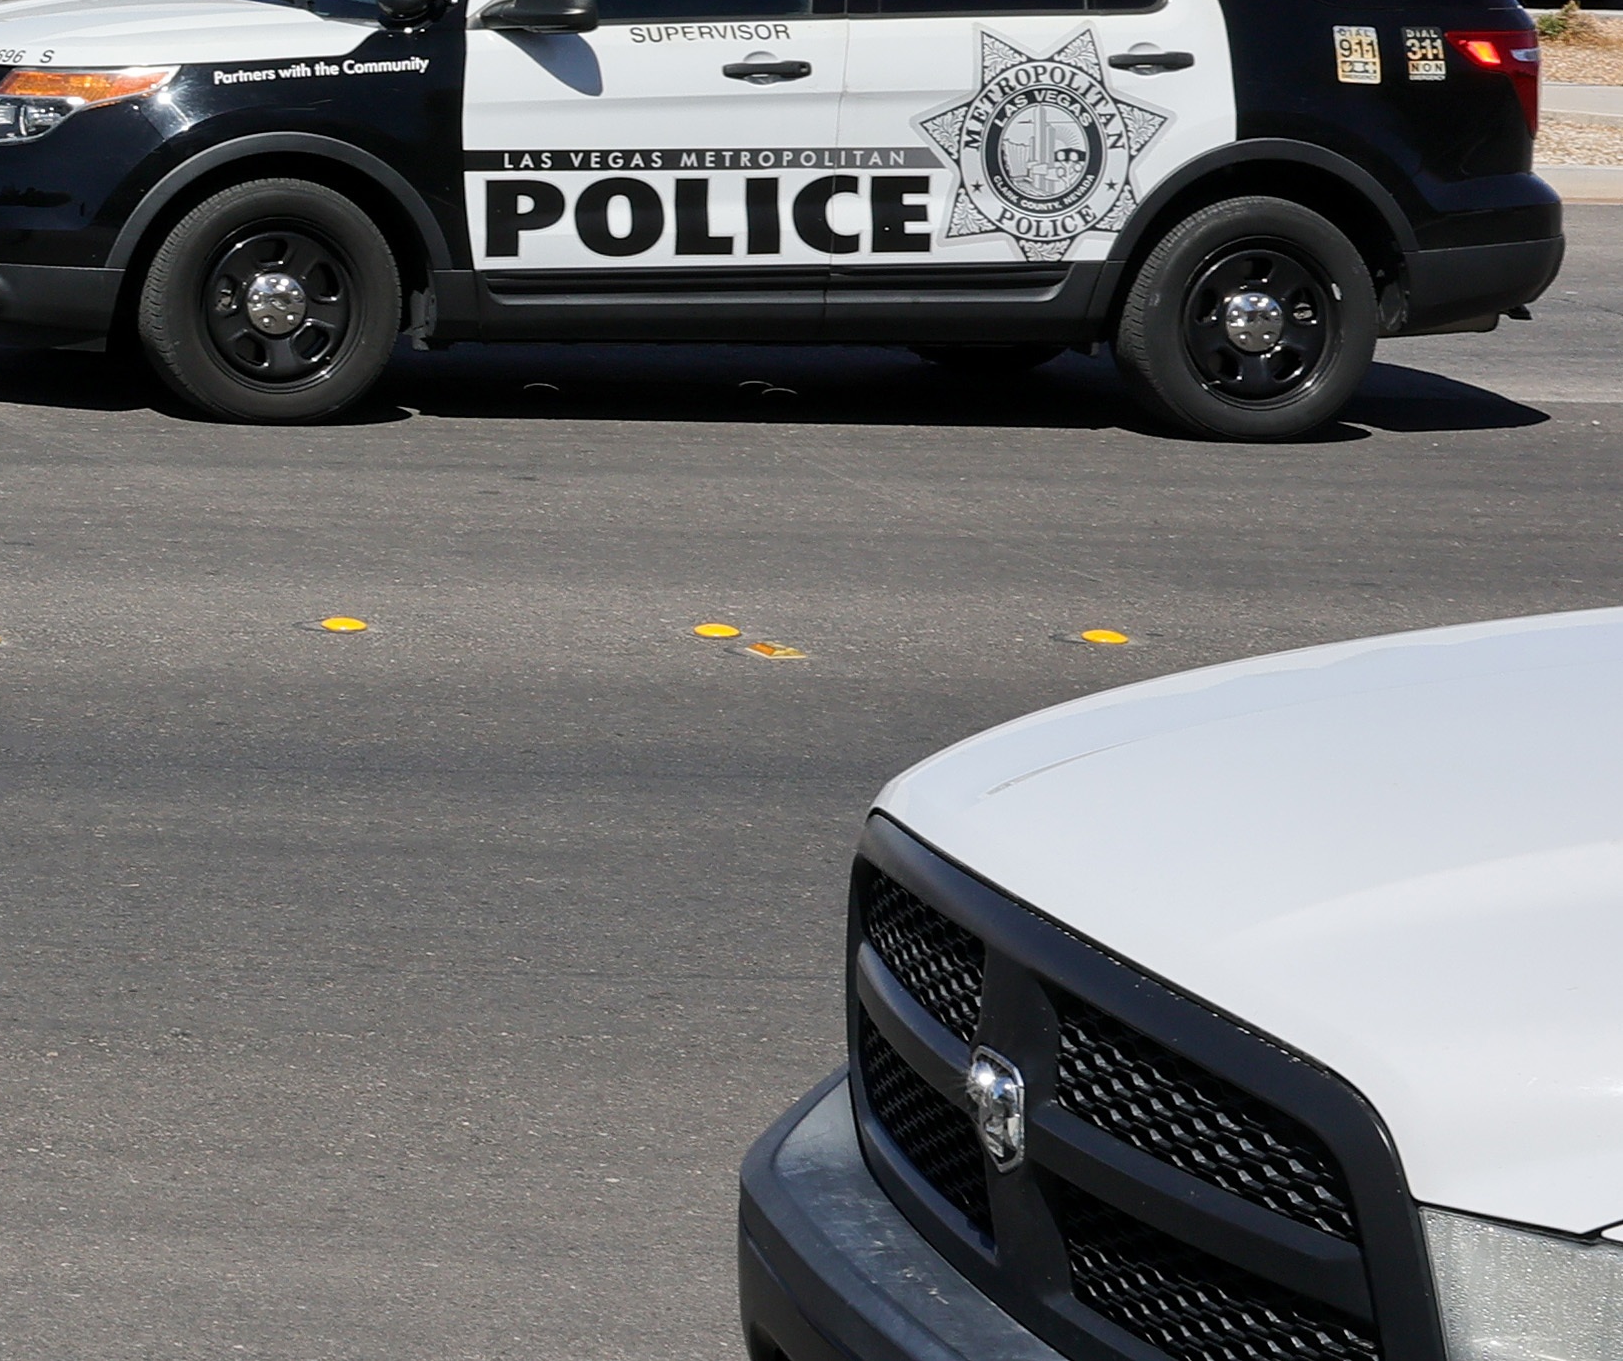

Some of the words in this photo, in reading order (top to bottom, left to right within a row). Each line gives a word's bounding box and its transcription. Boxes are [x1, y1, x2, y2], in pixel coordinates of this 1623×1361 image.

[631, 23, 791, 44] SUPERVISOR
[1337, 29, 1372, 37] DIAL
[1406, 29, 1438, 38] DIAL
[39, 49, 54, 64] S
[1411, 63, 1443, 72] NON
[214, 69, 276, 85] Partners
[278, 63, 312, 78] with
[314, 62, 339, 76] the
[342, 56, 429, 75] Community
[964, 65, 1125, 152] METROPOLITAN
[994, 94, 1028, 127] LAS
[1034, 90, 1092, 127] VEGAS
[504, 153, 552, 168] LAS
[570, 152, 663, 168] VEGAS
[681, 150, 906, 168] METROPOLITAN
[993, 174, 1020, 204] CLARK
[1064, 174, 1096, 205] NEVADA
[484, 176, 932, 258] POLICE
[997, 204, 1097, 237] POLICE
